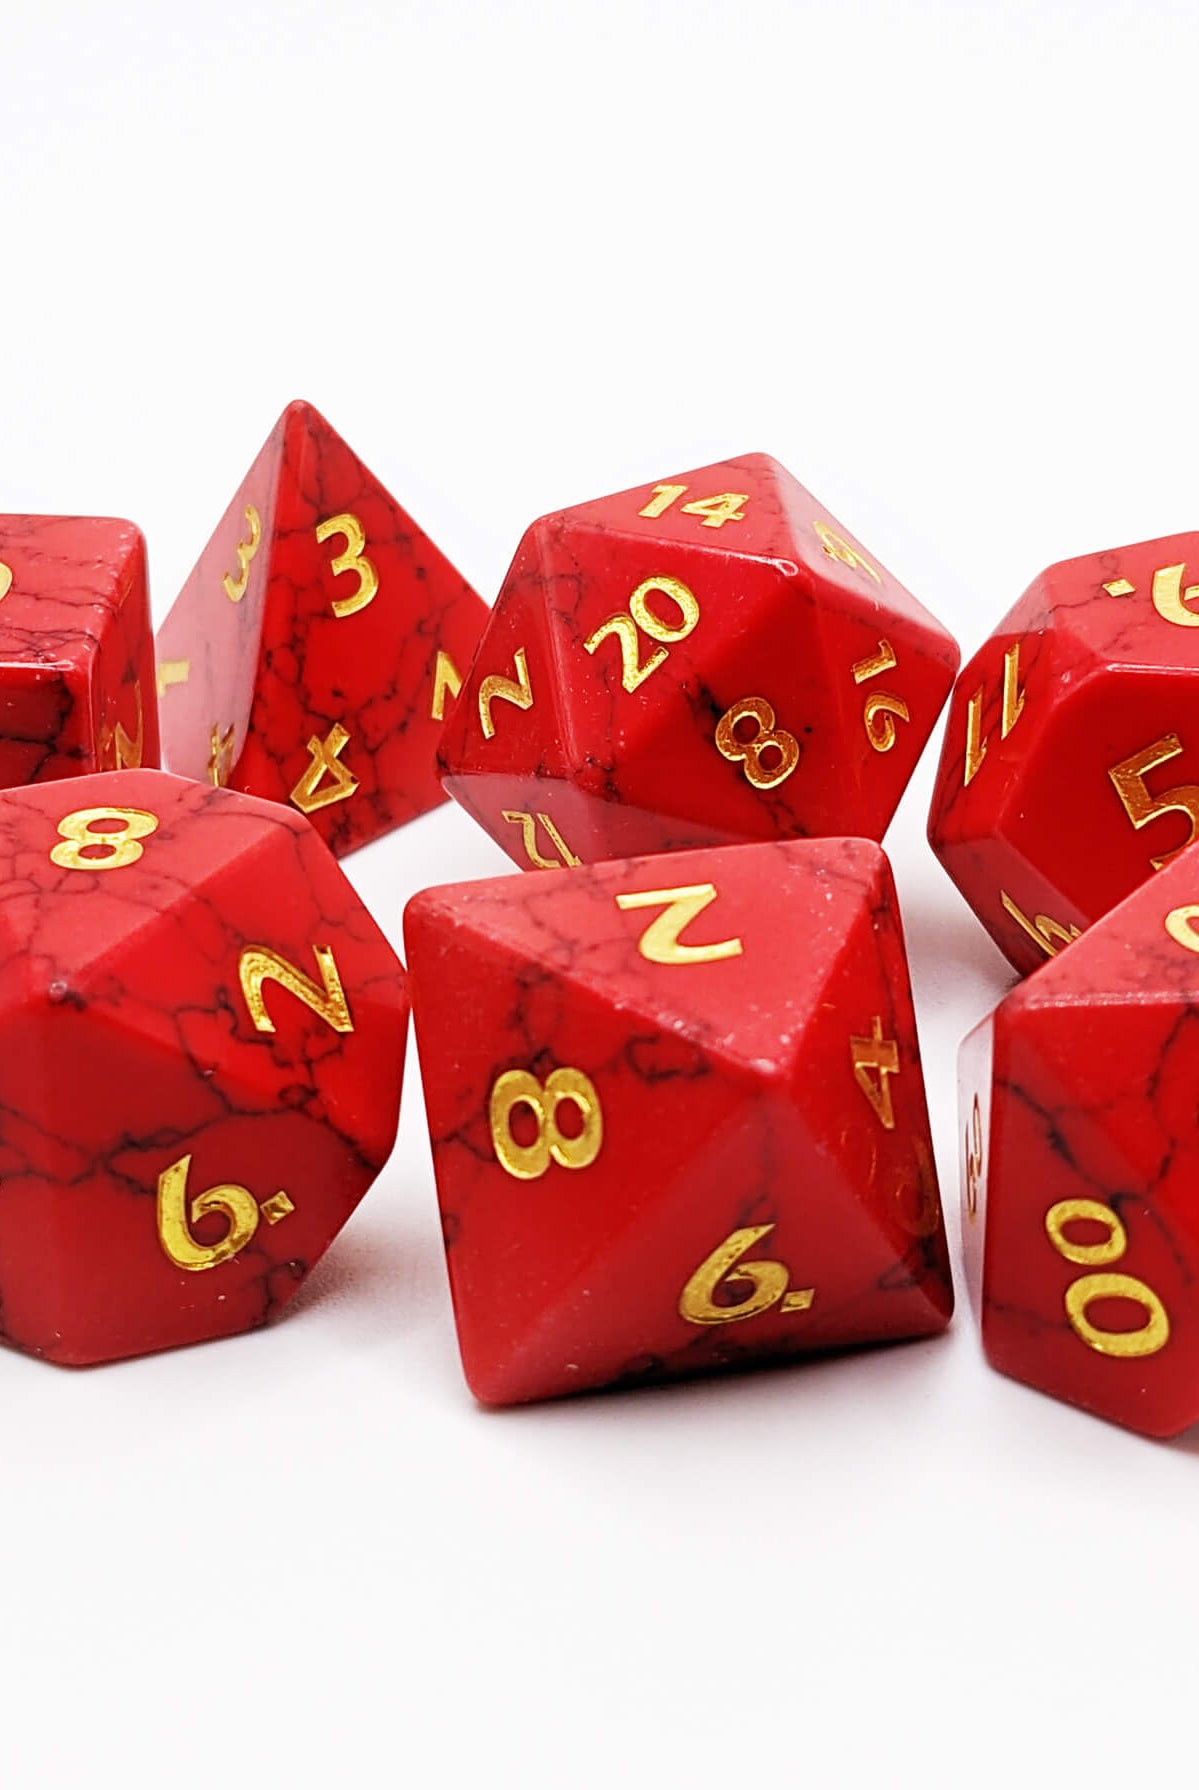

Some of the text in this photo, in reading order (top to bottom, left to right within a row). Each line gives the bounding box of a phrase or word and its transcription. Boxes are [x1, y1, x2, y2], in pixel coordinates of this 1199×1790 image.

[222, 504, 261, 602] 3
[638, 485, 749, 527] 14
[315, 513, 380, 618] 3
[583, 576, 699, 693] 20
[478, 647, 533, 738] 2
[851, 638, 910, 752] 16
[964, 641, 1025, 787] 11
[291, 722, 359, 813] 4
[715, 697, 799, 789] 8
[50, 807, 159, 871] 8
[501, 810, 582, 869] 12
[1108, 732, 1199, 870] 5
[615, 884, 743, 965] 2
[238, 944, 354, 1033] 2
[850, 1015, 900, 1129] 4
[489, 1067, 602, 1180] 8
[1045, 1199, 1170, 1358] 00
